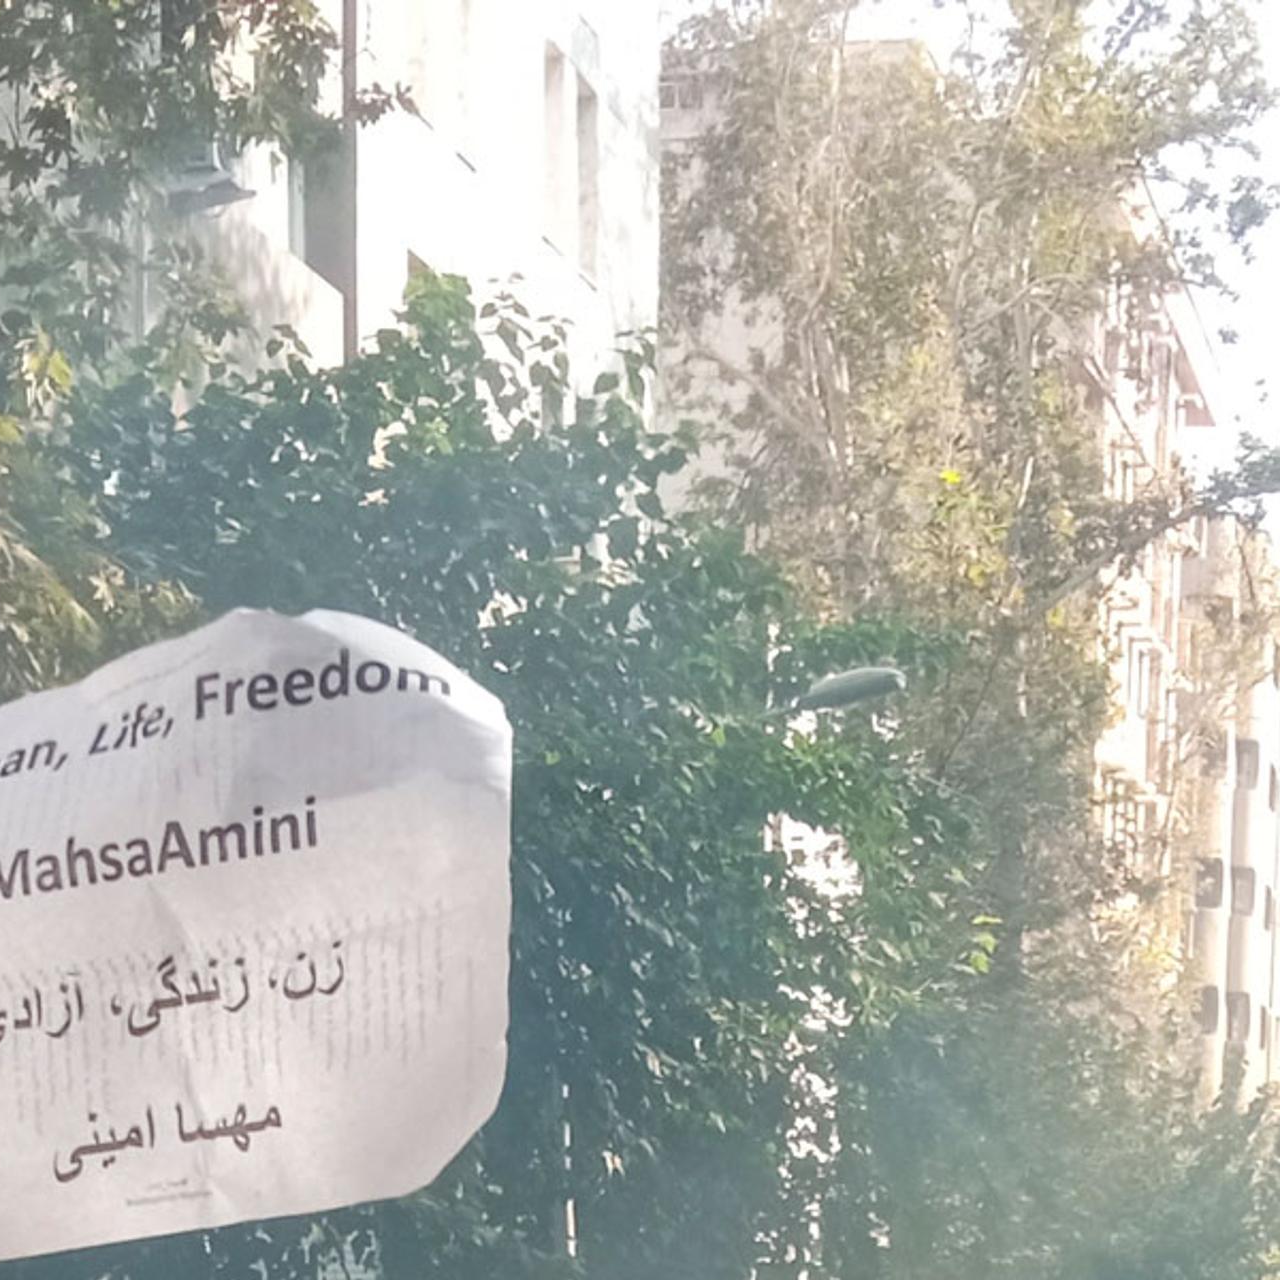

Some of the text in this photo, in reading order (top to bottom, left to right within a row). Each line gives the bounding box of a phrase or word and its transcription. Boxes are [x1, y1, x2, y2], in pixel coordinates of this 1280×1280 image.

[88, 703, 174, 755] Life,
[195, 648, 452, 721] Freedom
[111, 955, 250, 1038] زندگی،
[268, 940, 344, 1000] زن،
[53, 1103, 282, 1183] مهسا امینی
